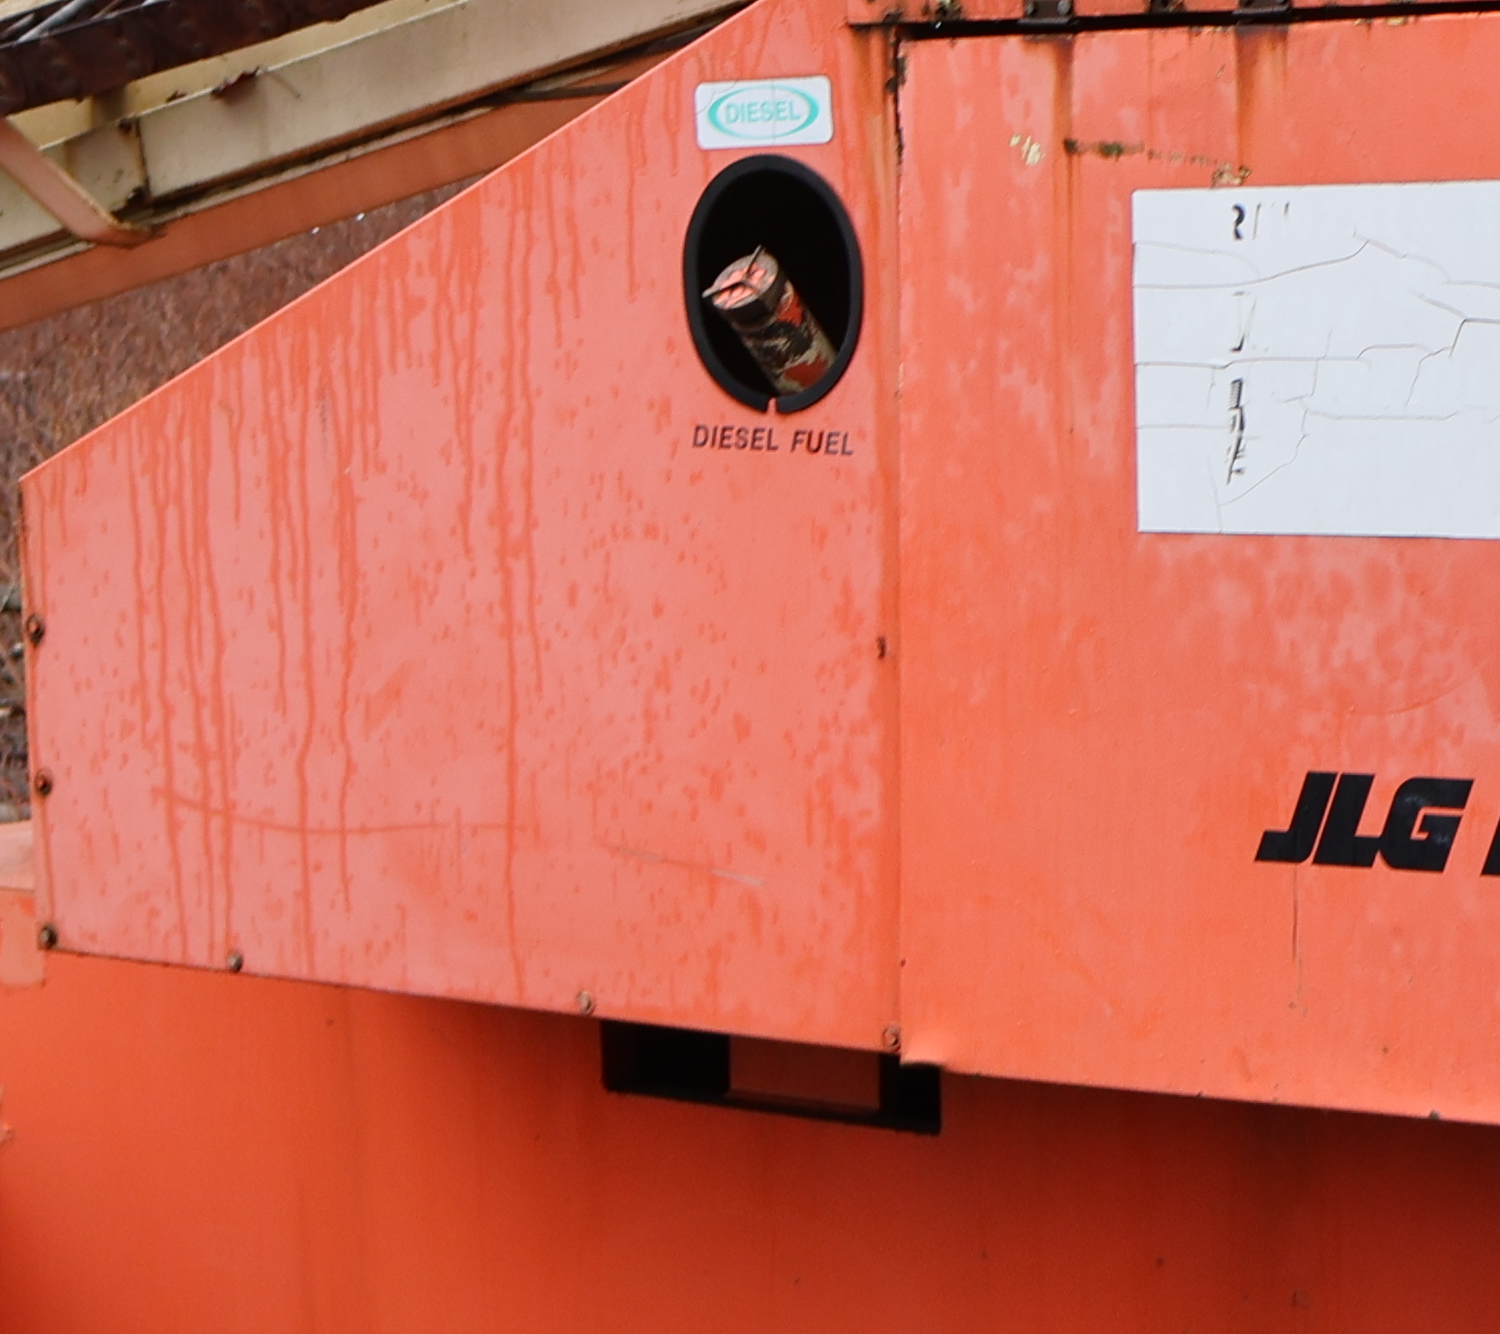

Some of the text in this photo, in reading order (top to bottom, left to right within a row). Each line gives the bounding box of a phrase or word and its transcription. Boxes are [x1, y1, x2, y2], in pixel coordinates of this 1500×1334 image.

[726, 100, 801, 124] DIESEL
[692, 424, 854, 456] DIESEL FUEL
[1254, 771, 1476, 871] JLG
